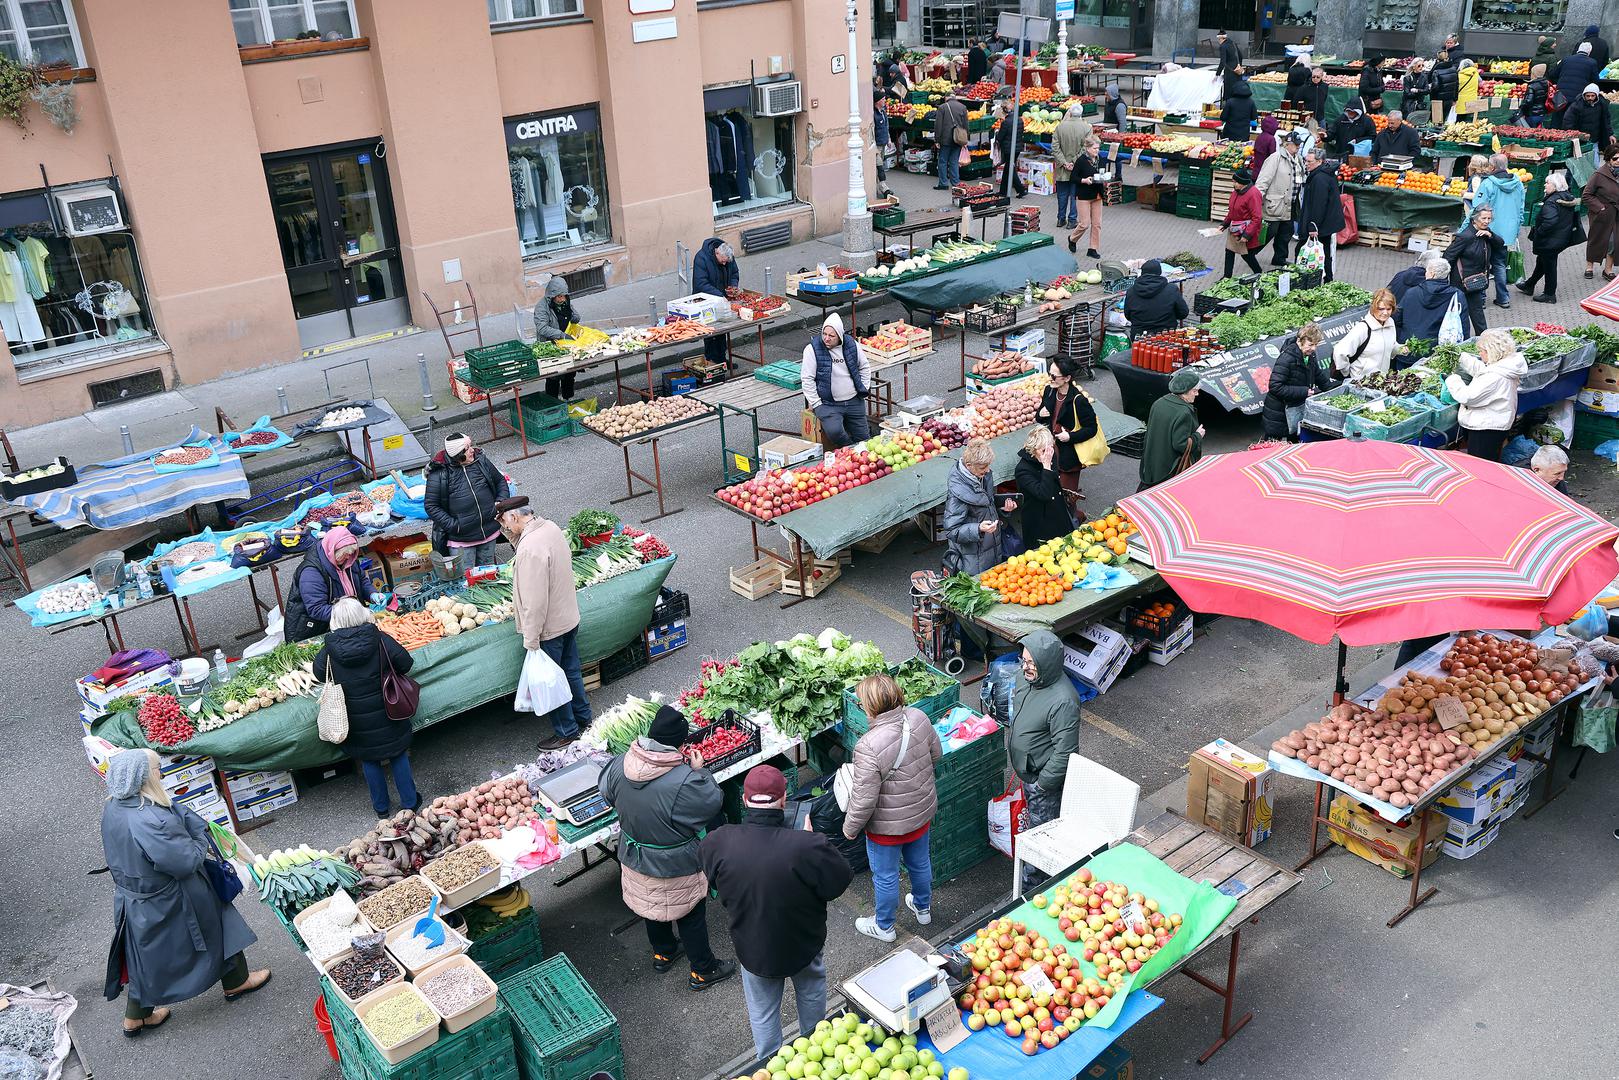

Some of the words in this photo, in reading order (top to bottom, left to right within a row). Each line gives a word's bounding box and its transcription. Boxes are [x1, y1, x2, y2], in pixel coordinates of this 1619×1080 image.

[516, 115, 577, 139] CENTRA
[1084, 625, 1111, 643] BANA
[1064, 653, 1087, 670] BONI
[1331, 813, 1369, 836] BANANAS
